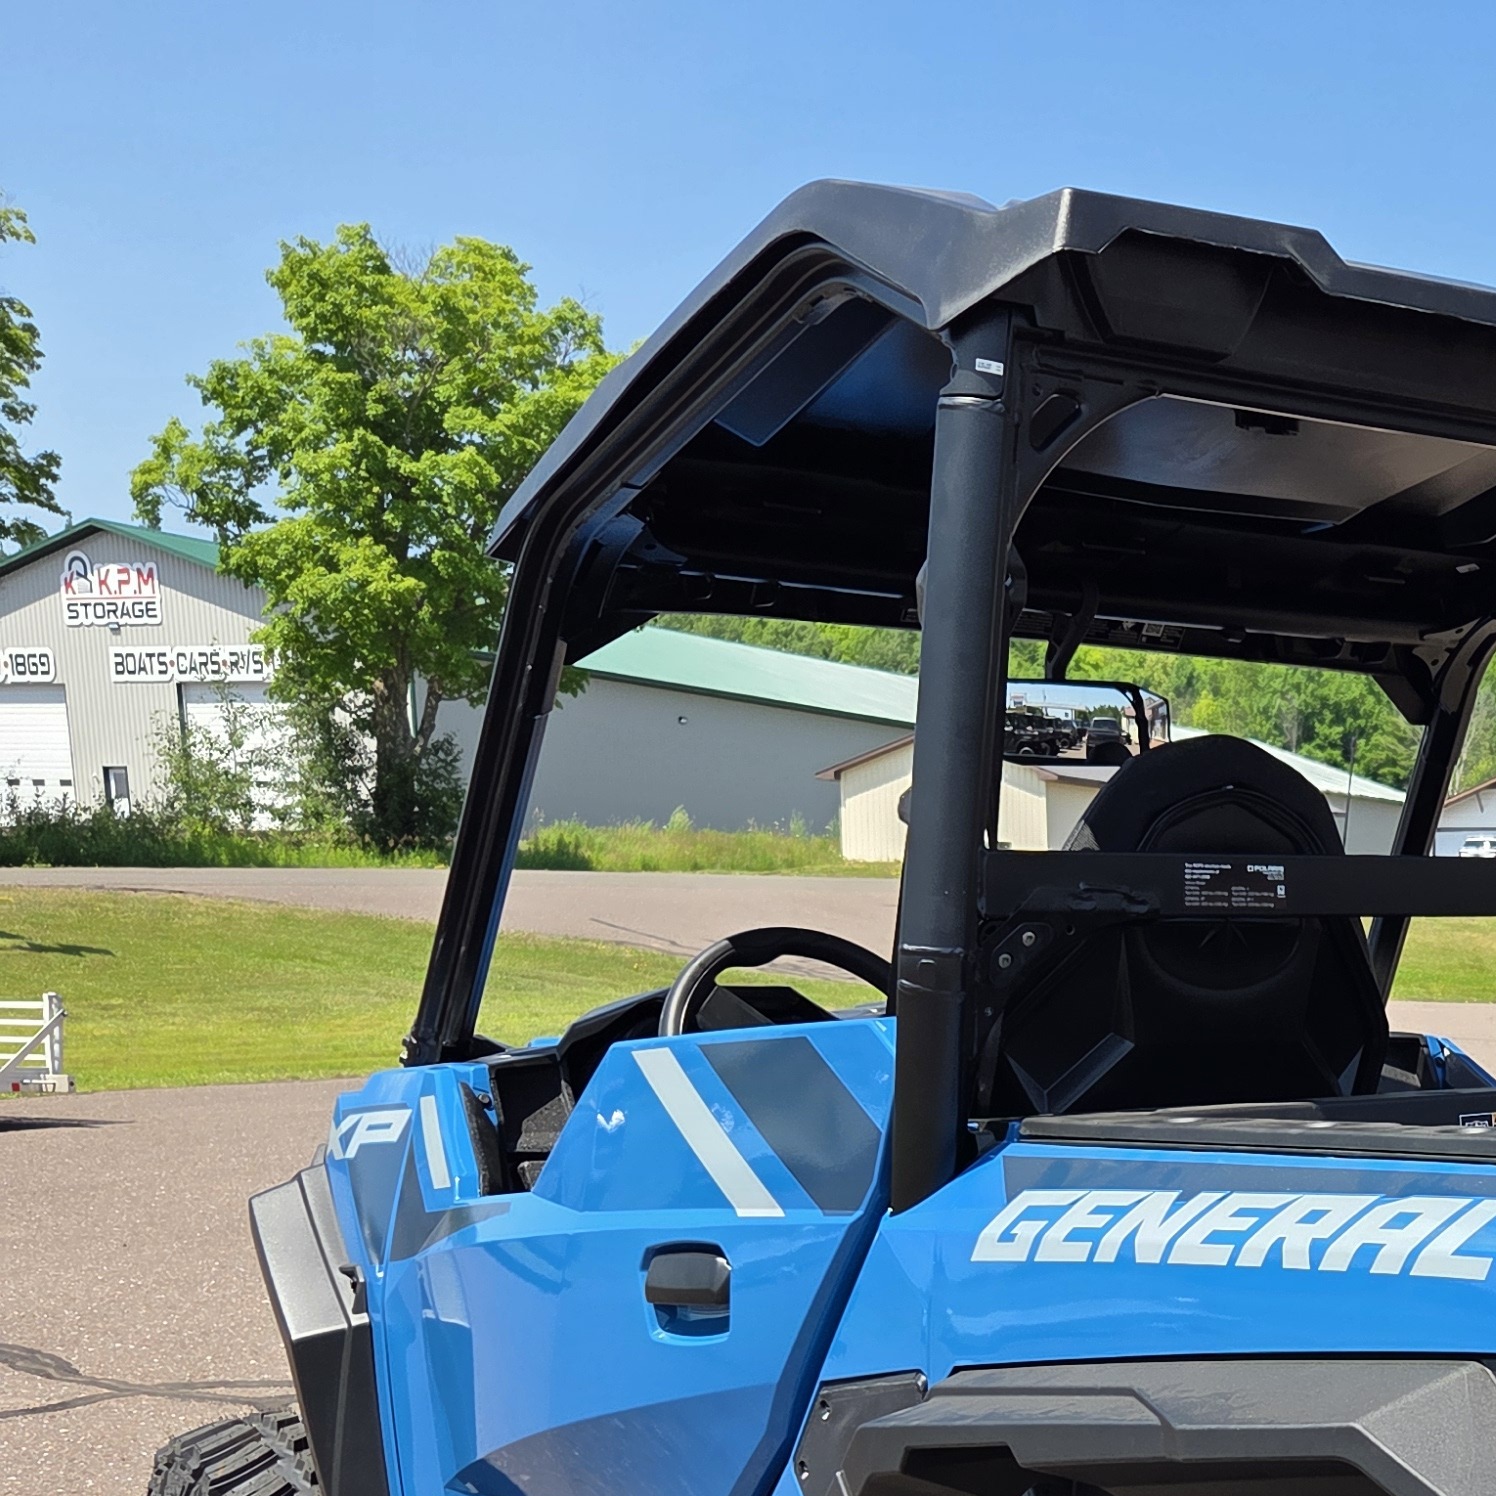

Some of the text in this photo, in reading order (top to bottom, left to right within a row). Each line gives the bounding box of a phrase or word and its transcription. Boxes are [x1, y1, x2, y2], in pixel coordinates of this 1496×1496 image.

[67, 601, 158, 620] STORAGE
[8, 653, 51, 676] 1869
[114, 652, 168, 676] BOATS
[327, 1109, 413, 1161] XP
